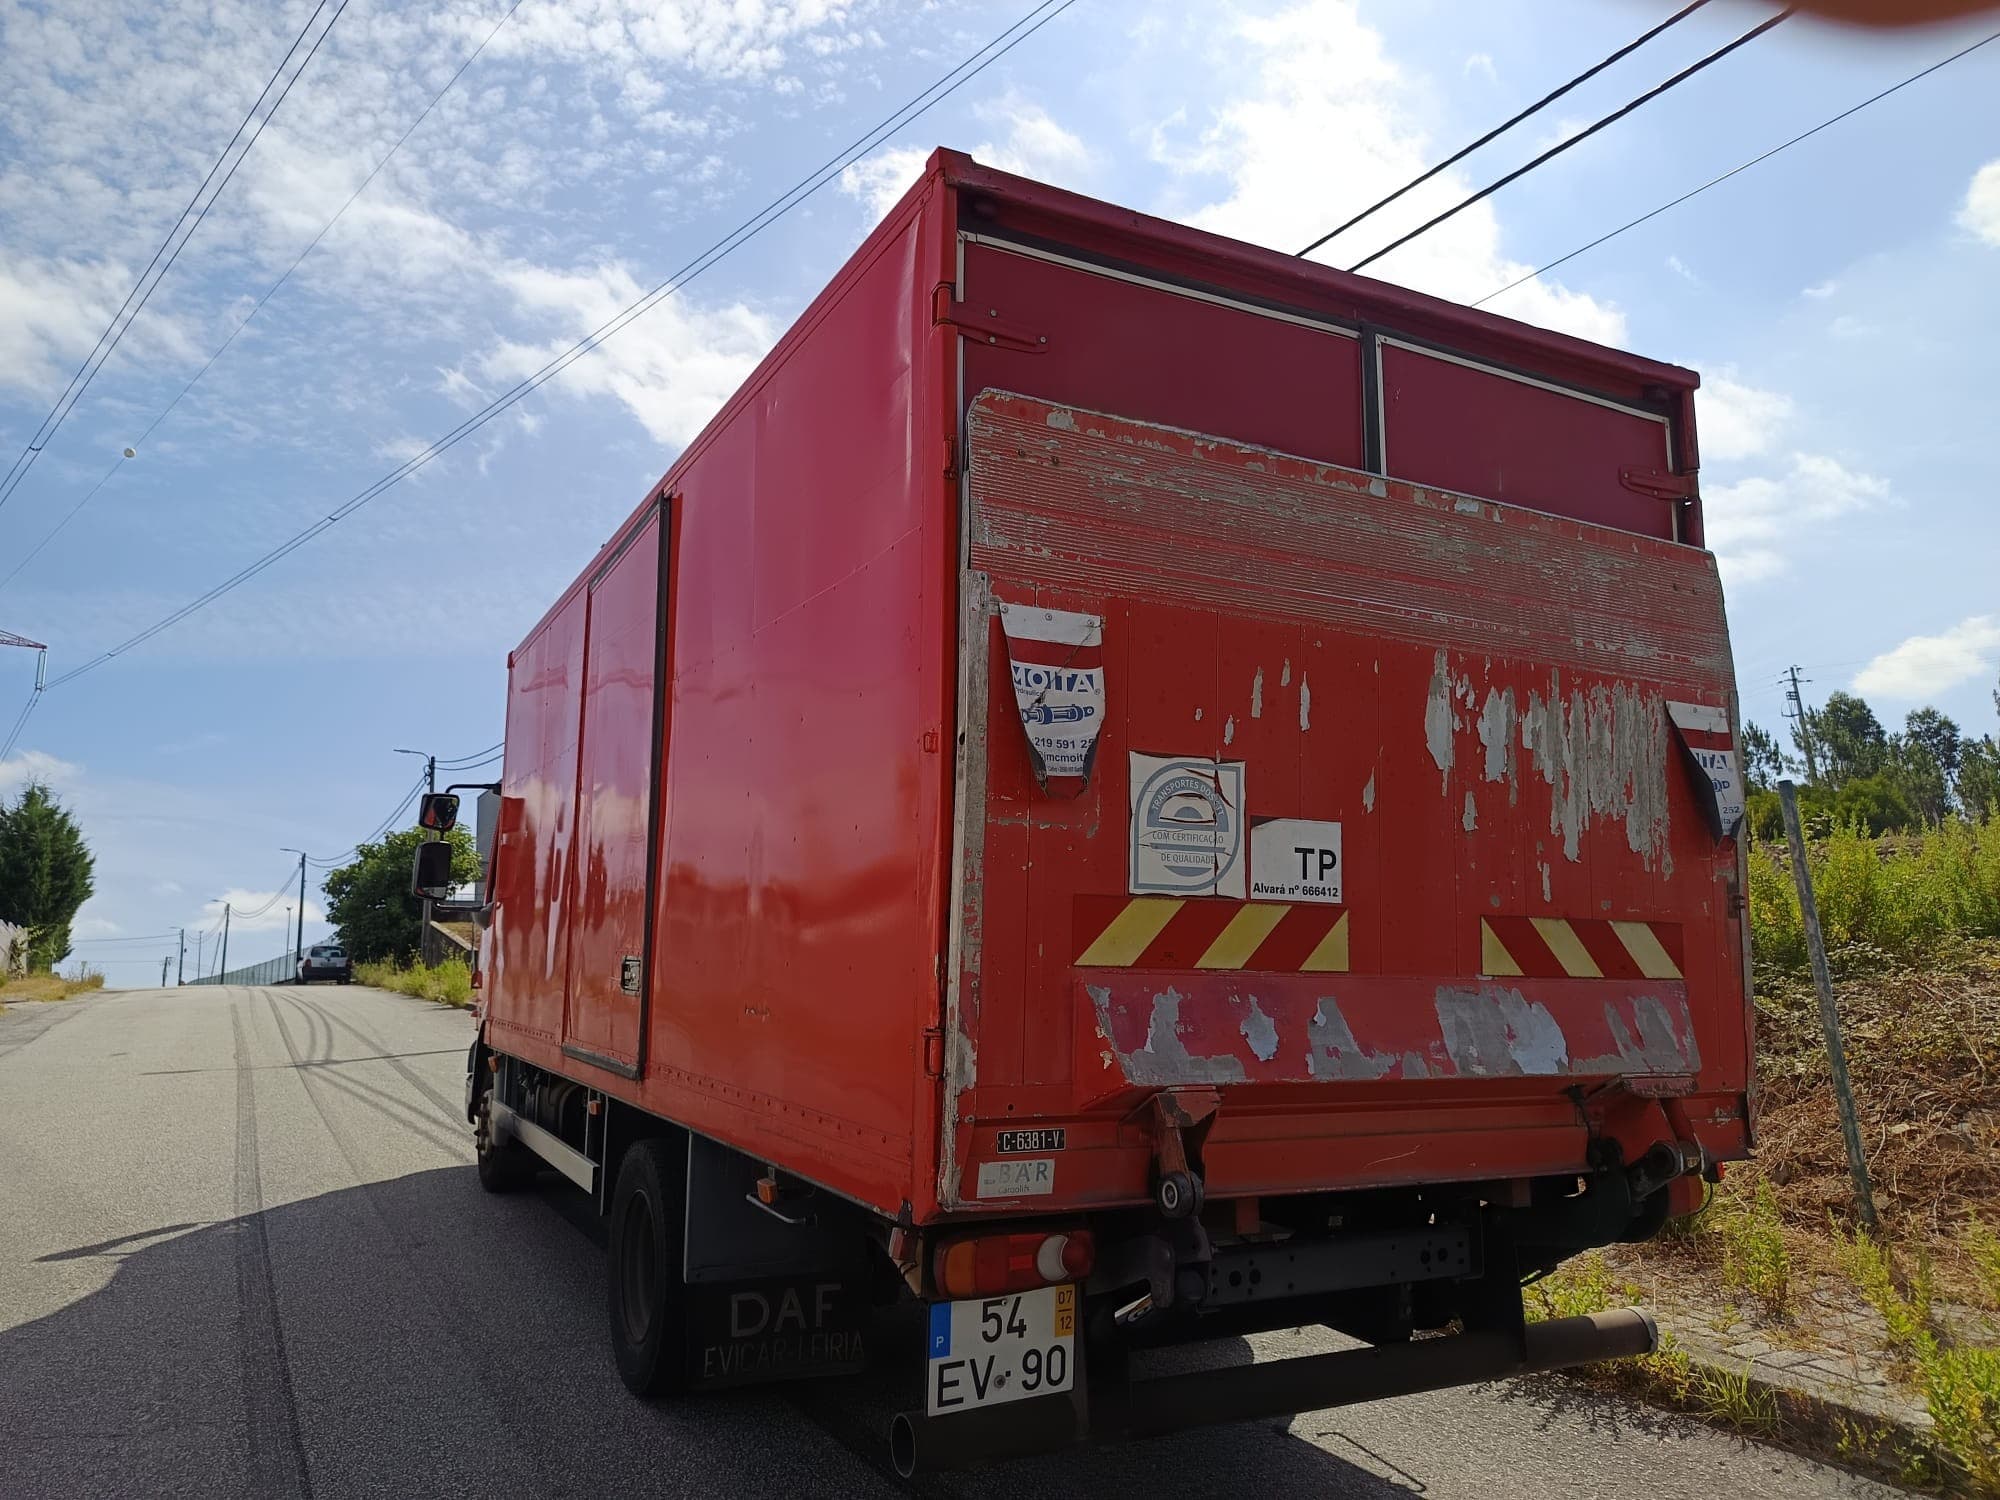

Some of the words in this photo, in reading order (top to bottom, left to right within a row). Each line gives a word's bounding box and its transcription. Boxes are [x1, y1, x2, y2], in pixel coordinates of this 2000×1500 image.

[1034, 736, 1053, 748] 219
[1056, 739, 1076, 749] 591
[1151, 778, 1200, 811] TRANSPORTES
[1200, 784, 1216, 802] DOS
[1152, 832, 1170, 841] COM
[1160, 853, 1171, 862] DE
[1173, 854, 1215, 865] QUALIDADE
[1294, 847, 1337, 882] TP
[1253, 882, 1286, 895] Alvará
[1288, 886, 1300, 895] nº
[1302, 886, 1339, 897] 666412
[1003, 1131, 1059, 1151] C-6381-V
[1058, 1290, 1072, 1304] 07
[730, 1283, 842, 1338] DAF
[981, 1296, 1027, 1343] 54
[1060, 1315, 1072, 1330] 12
[936, 1336, 944, 1348] P
